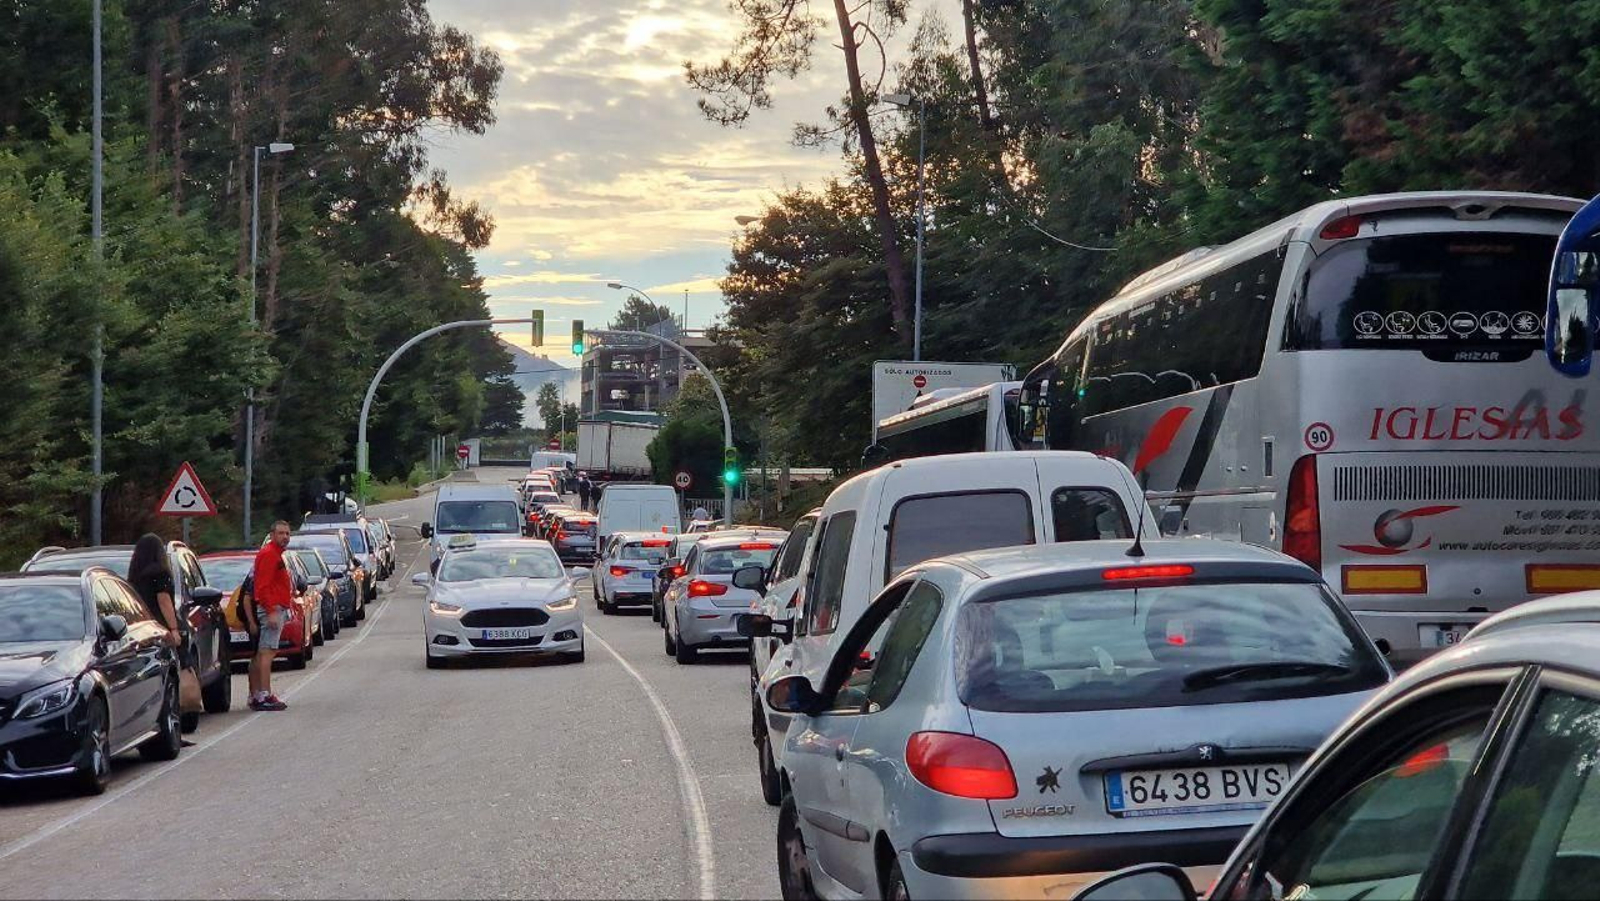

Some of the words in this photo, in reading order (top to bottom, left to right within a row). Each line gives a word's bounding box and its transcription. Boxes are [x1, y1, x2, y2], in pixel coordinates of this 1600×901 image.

[1454, 351, 1500, 361] IRIZAR
[1368, 405, 1584, 441] IGLESIAS
[1310, 430, 1327, 444] 90
[676, 475, 690, 483] 40
[1129, 772, 1212, 804] 6438
[1223, 768, 1283, 799] BVS
[1001, 804, 1076, 819] PEUGEOT
